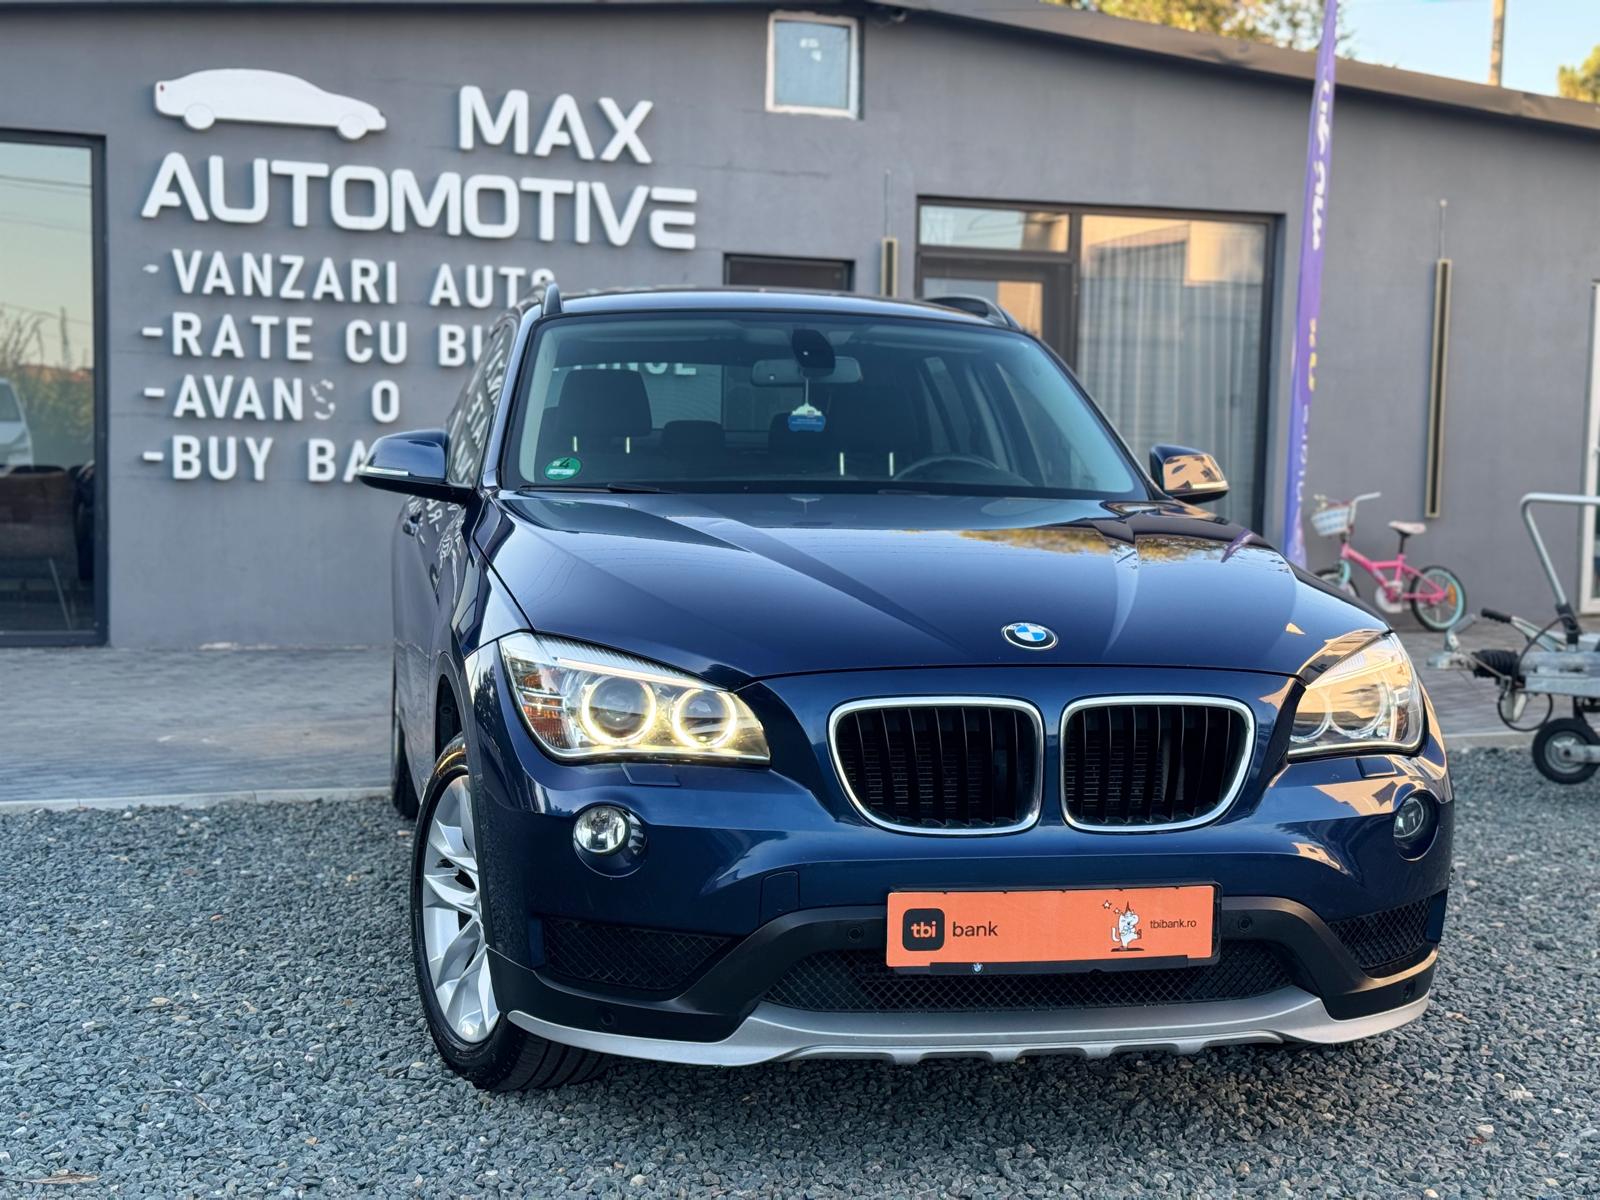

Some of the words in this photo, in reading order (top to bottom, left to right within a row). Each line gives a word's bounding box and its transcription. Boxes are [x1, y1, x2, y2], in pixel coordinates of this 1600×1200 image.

[459, 84, 654, 164] MAX
[142, 152, 698, 249] AUTOMOTIVE
[345, 319, 407, 364] CU
[911, 920, 937, 938] tbi
[952, 920, 998, 937] bank
[1149, 918, 1197, 929] tbibank.ro
